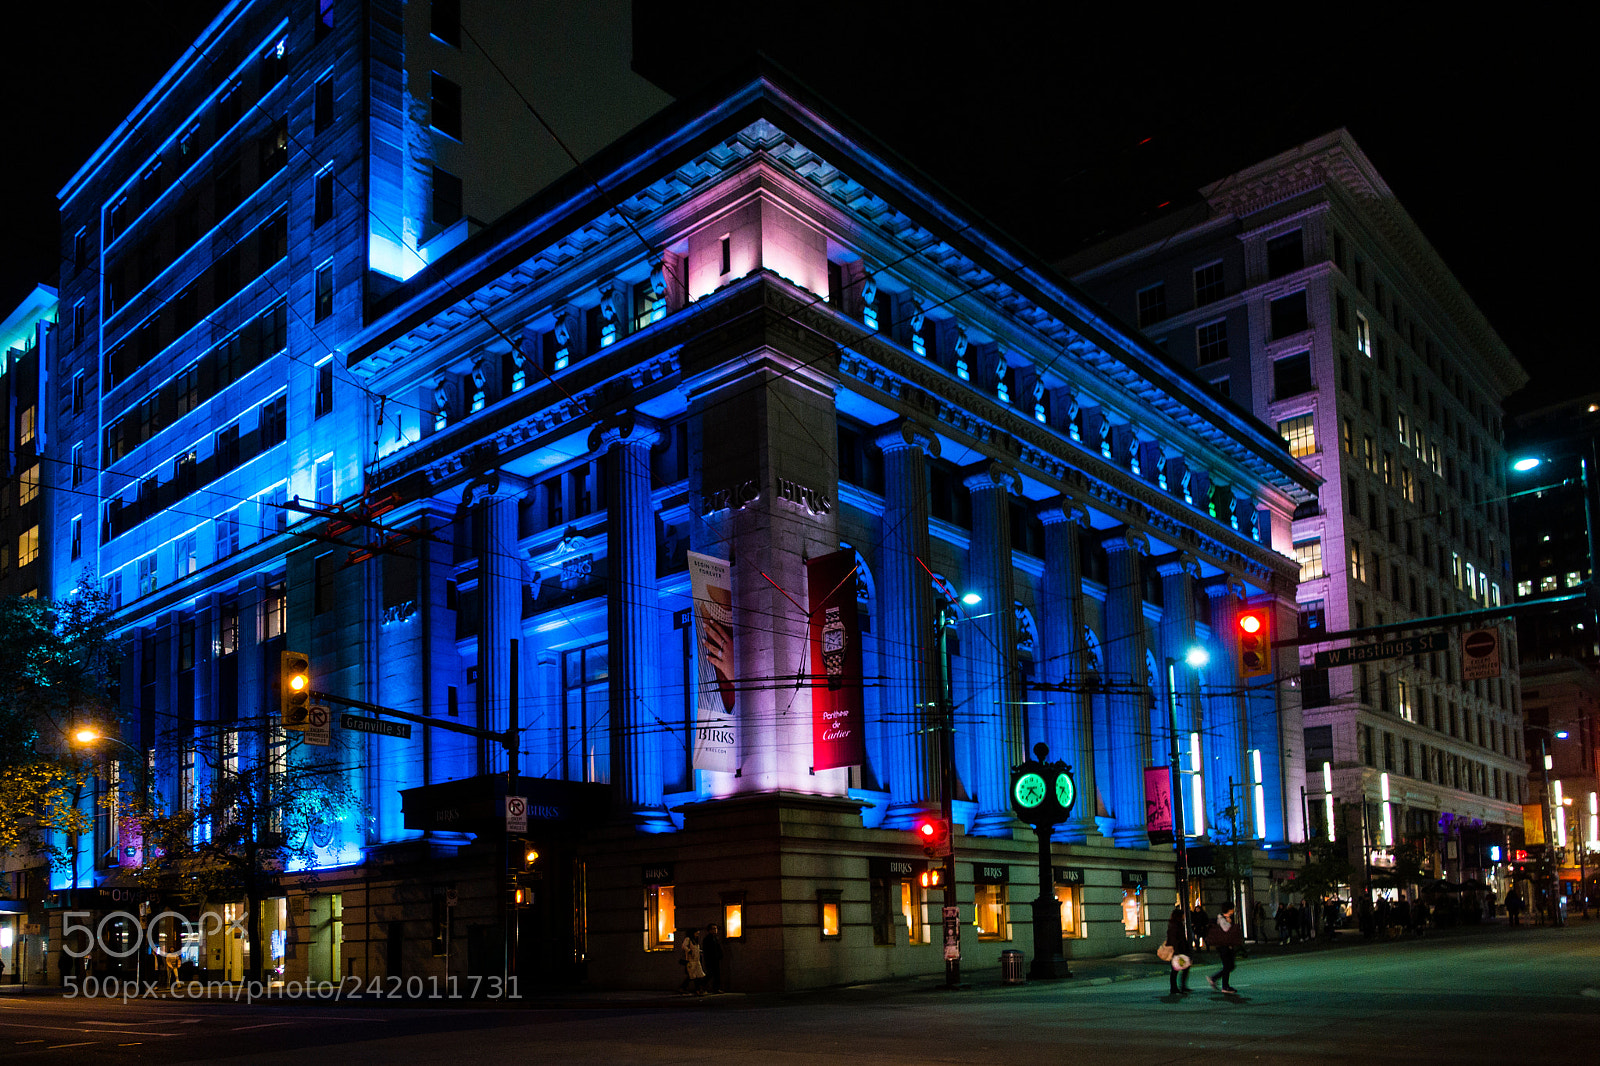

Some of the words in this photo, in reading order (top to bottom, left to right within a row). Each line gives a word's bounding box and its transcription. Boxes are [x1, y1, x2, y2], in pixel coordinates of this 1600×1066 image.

[776, 477, 832, 516] BIRKS
[1328, 651, 1341, 664] W
[1346, 640, 1412, 661] Hastings
[1419, 635, 1434, 650] St
[346, 717, 393, 735] Granville
[396, 725, 406, 737] St
[832, 720, 841, 729] de
[698, 728, 735, 745] BIRKS
[822, 729, 851, 741] Cartier
[527, 804, 560, 820] BIRKS
[645, 867, 669, 879] BIRKS
[890, 861, 913, 875] BIRKS
[983, 866, 1003, 879] BIRKS
[1188, 865, 1216, 877] BIRKS
[1062, 870, 1079, 881] BIRKS
[99, 889, 110, 897] The
